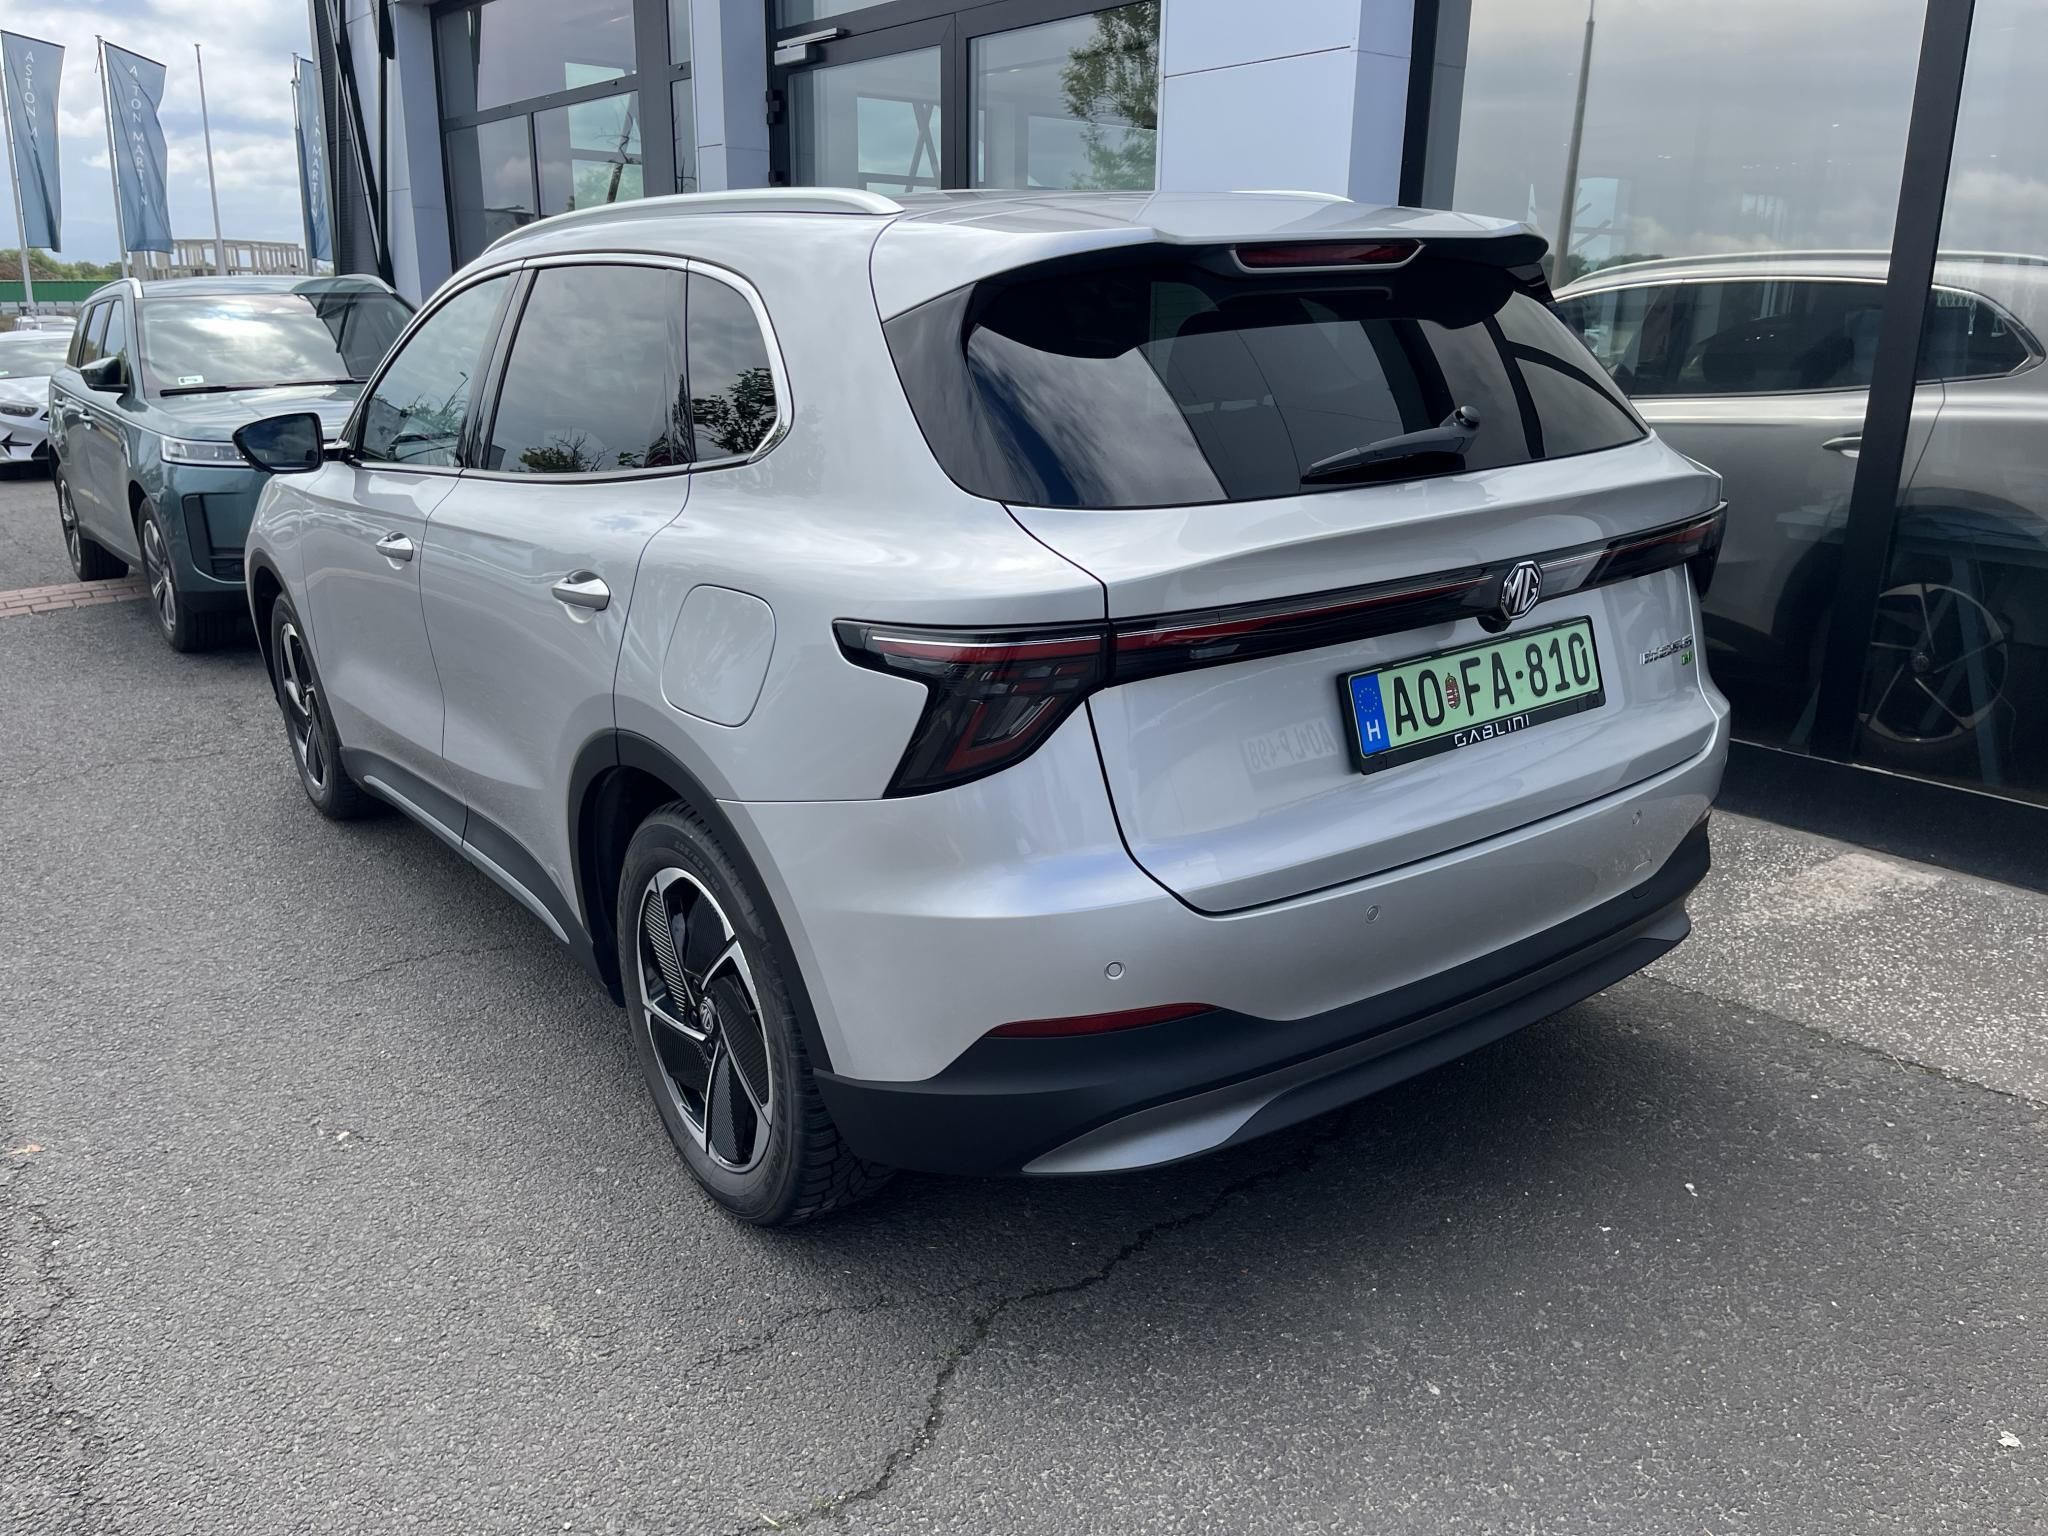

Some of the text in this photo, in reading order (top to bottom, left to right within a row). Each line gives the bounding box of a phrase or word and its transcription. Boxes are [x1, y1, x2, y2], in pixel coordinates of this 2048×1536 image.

[24, 51, 36, 118] ASTON
[129, 65, 148, 206] ATON MARTIN
[1503, 566, 1540, 615] MG
[1366, 719, 1382, 742] H
[1393, 669, 1445, 737] AO
[1454, 714, 1531, 748] GABLINI
